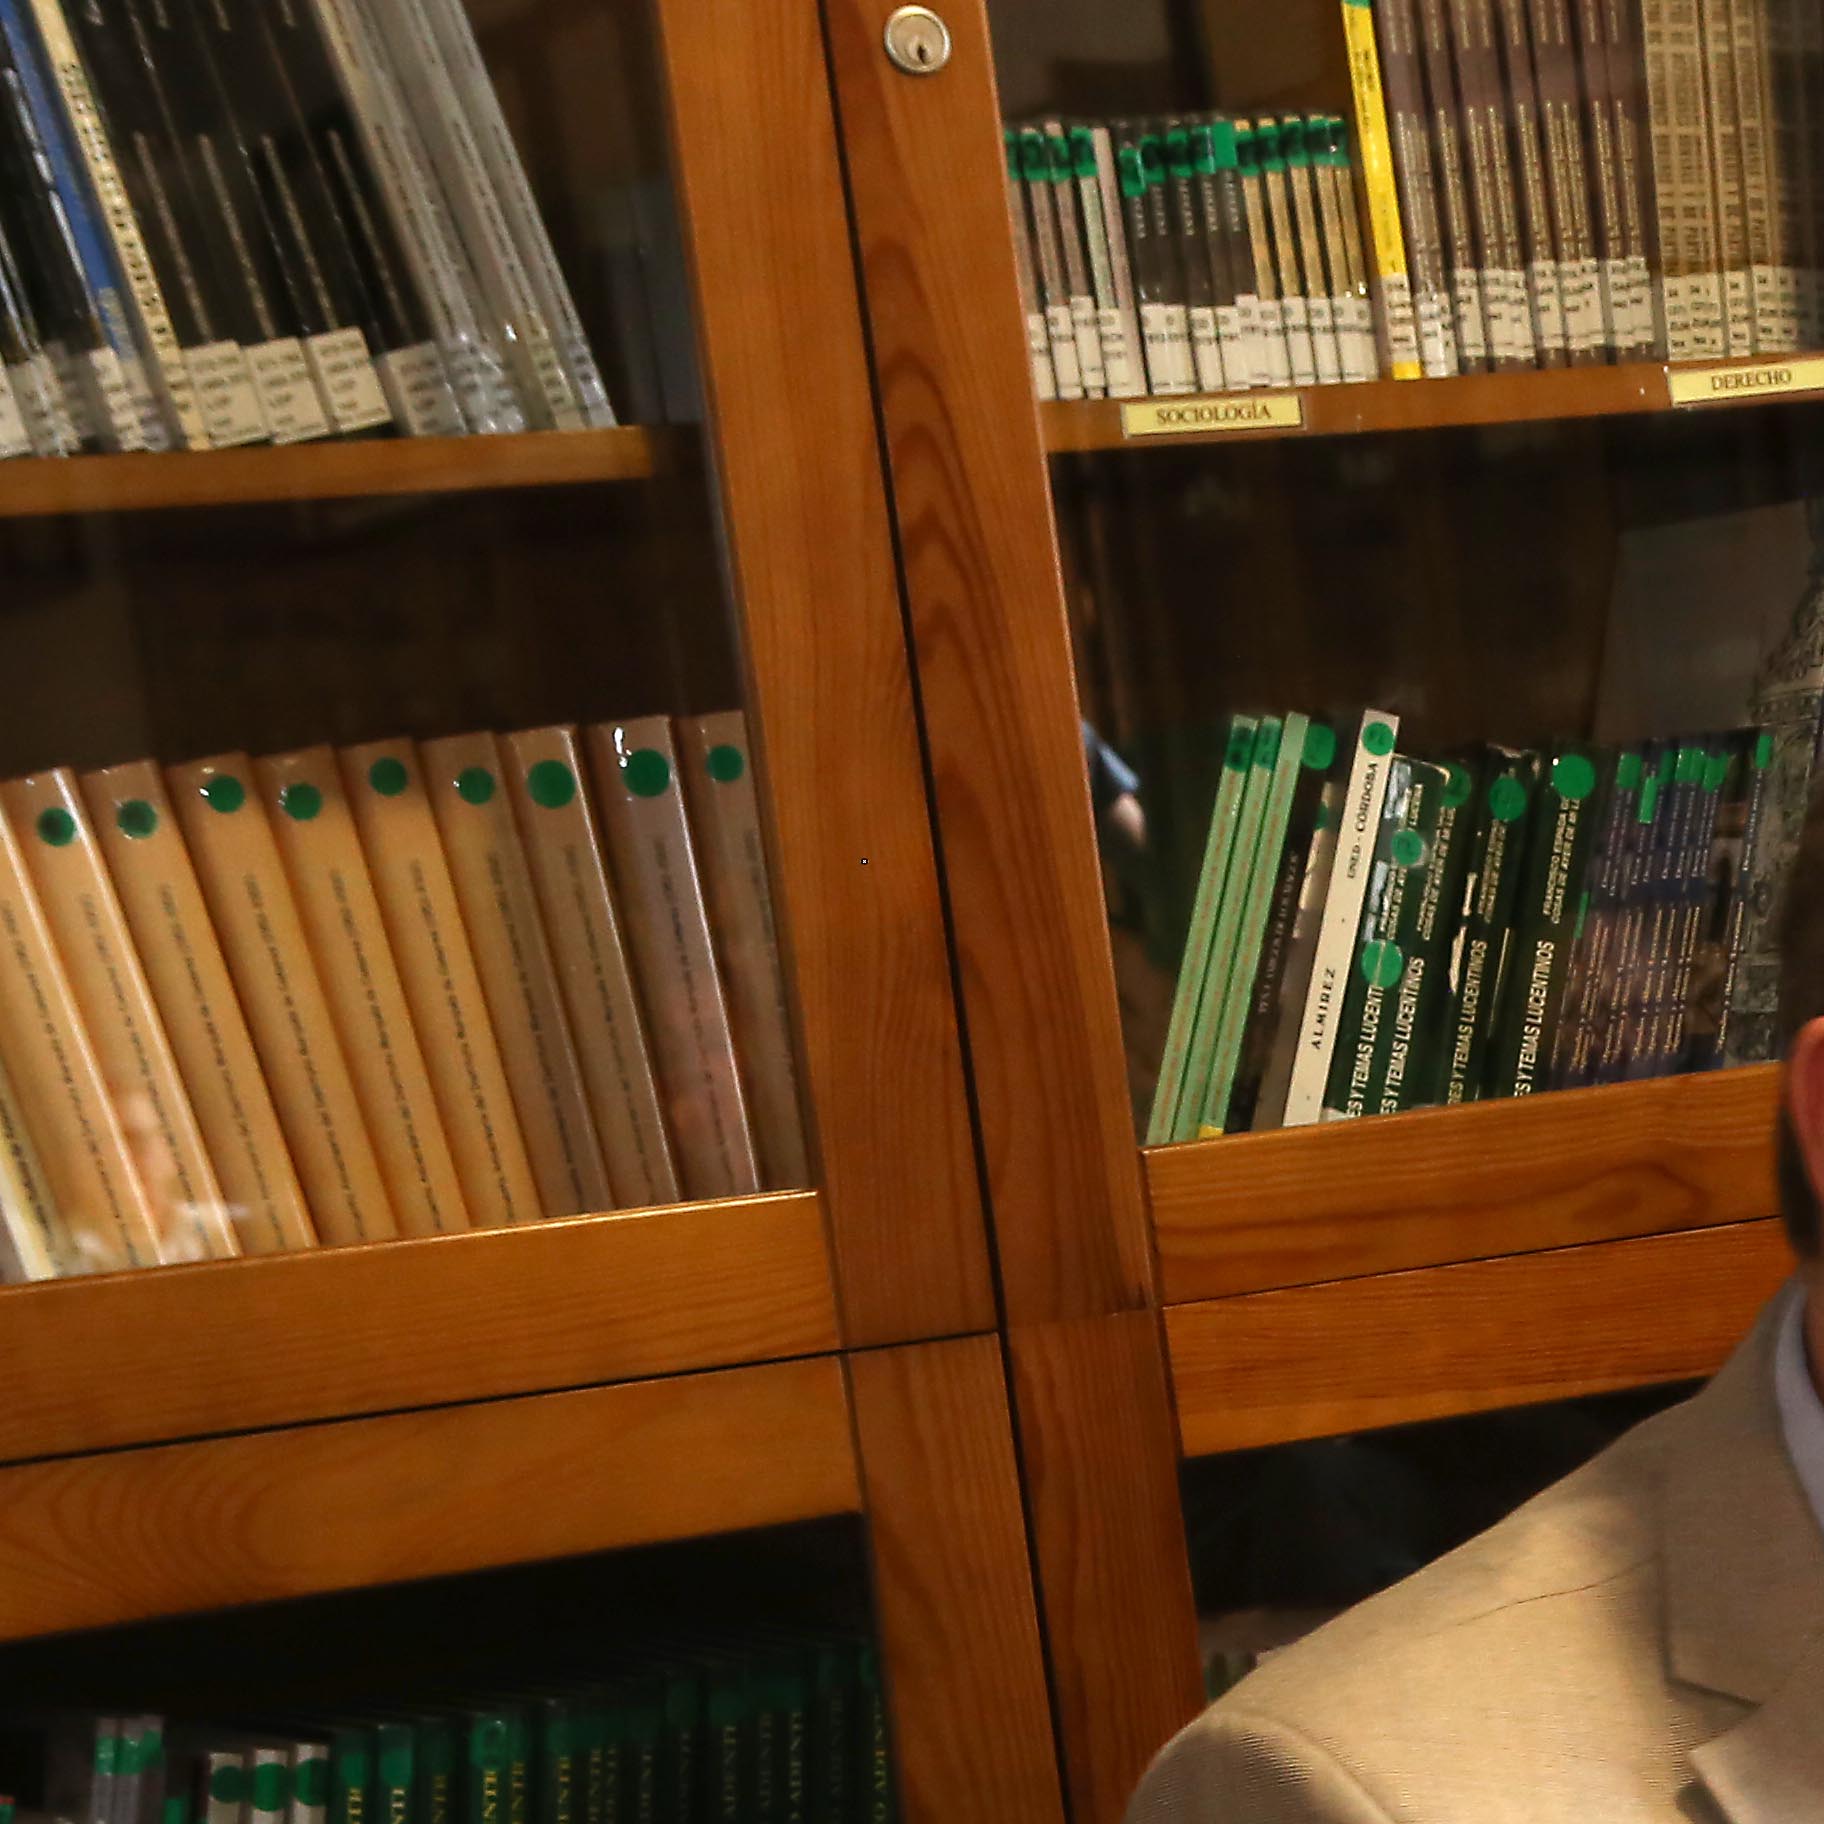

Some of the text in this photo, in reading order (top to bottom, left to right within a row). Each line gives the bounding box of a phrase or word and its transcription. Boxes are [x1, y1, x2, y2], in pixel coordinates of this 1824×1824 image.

[1711, 368, 1792, 391] DERECHO
[1156, 397, 1272, 425] SOCIOLOGÍA
[1345, 760, 1378, 879] UNED CÓRDOBA
[1542, 854, 1561, 916] FRANCISCO
[1550, 887, 1566, 924] COSAS
[1556, 871, 1568, 887] DE
[1308, 966, 1336, 1050] ALMIREZ
[1358, 983, 1384, 1042] LUCENTI
[1383, 956, 1425, 1098] Y TEMAS LUCENTINOS
[1449, 938, 1487, 1080] Y TEMAS LUCENTINOS
[1516, 939, 1555, 1083] Y TEMAS LUCENTINOS
[1350, 1043, 1374, 1090] TEMAS
